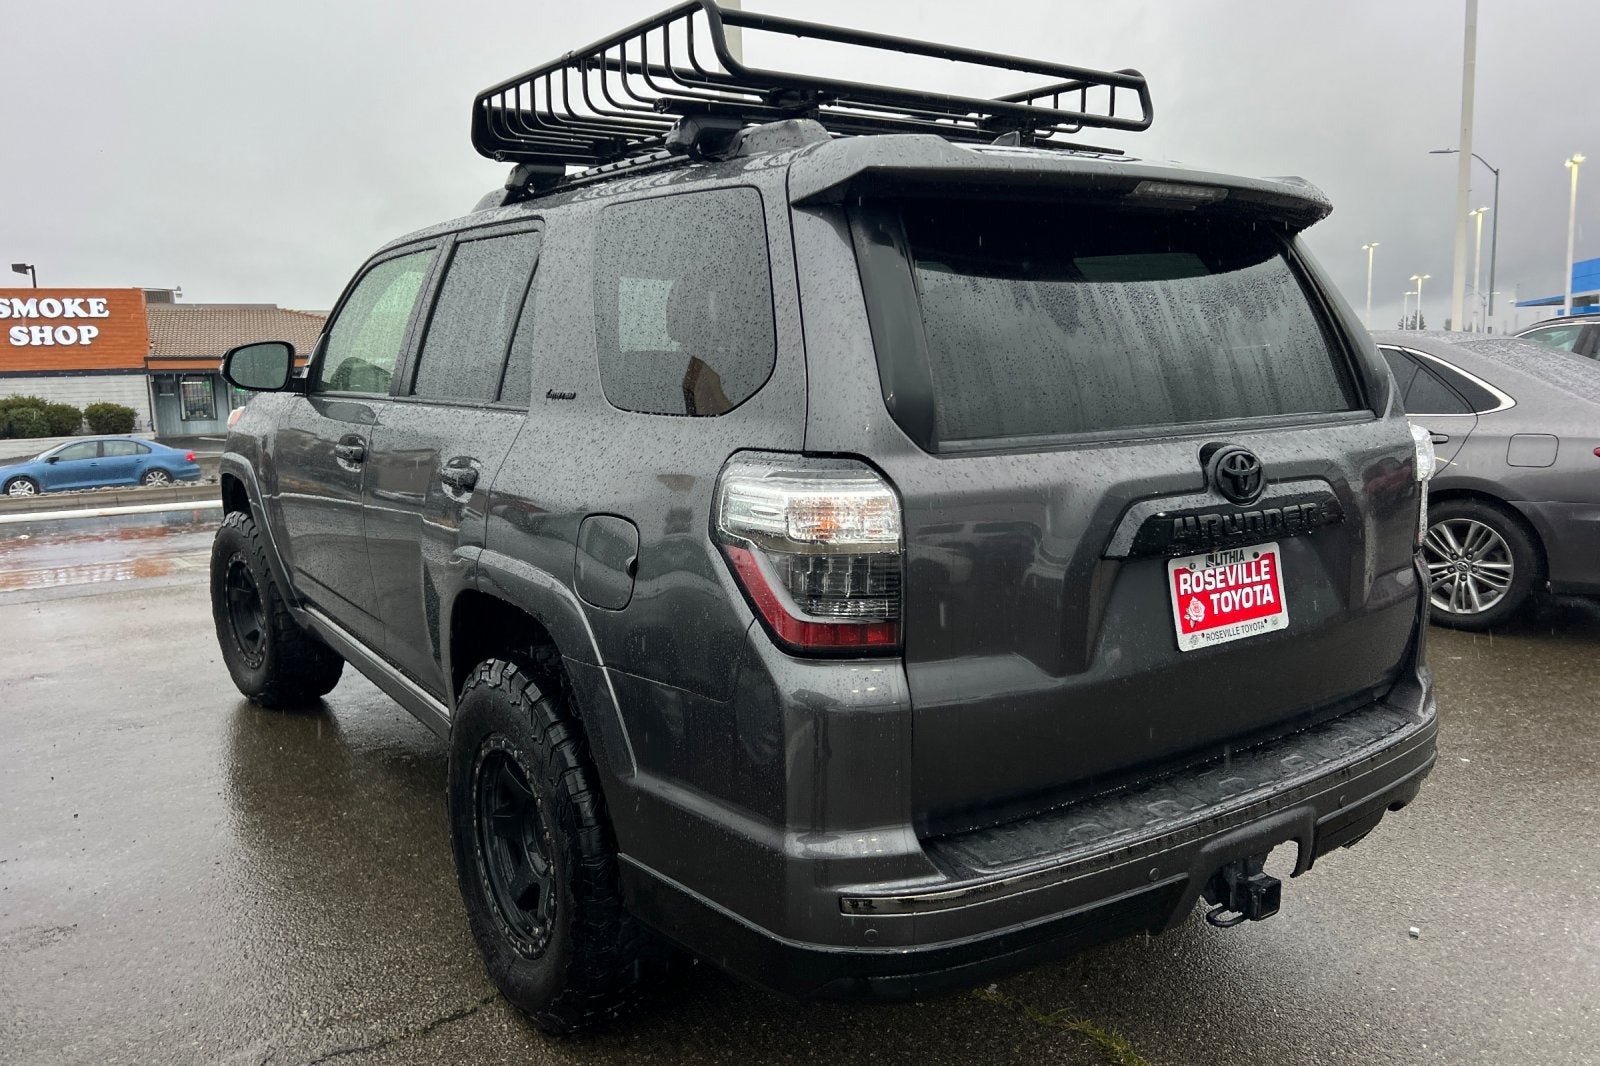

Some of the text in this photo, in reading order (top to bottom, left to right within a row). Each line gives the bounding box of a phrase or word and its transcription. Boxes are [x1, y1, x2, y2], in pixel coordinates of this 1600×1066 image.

[9, 325, 99, 346] SHOP
[1214, 549, 1246, 567] LITHIA
[1180, 559, 1271, 596] ROSEVILLE
[1209, 583, 1275, 615] TOYOTA
[1206, 620, 1265, 642] ROSEVILLE TOYOTA
